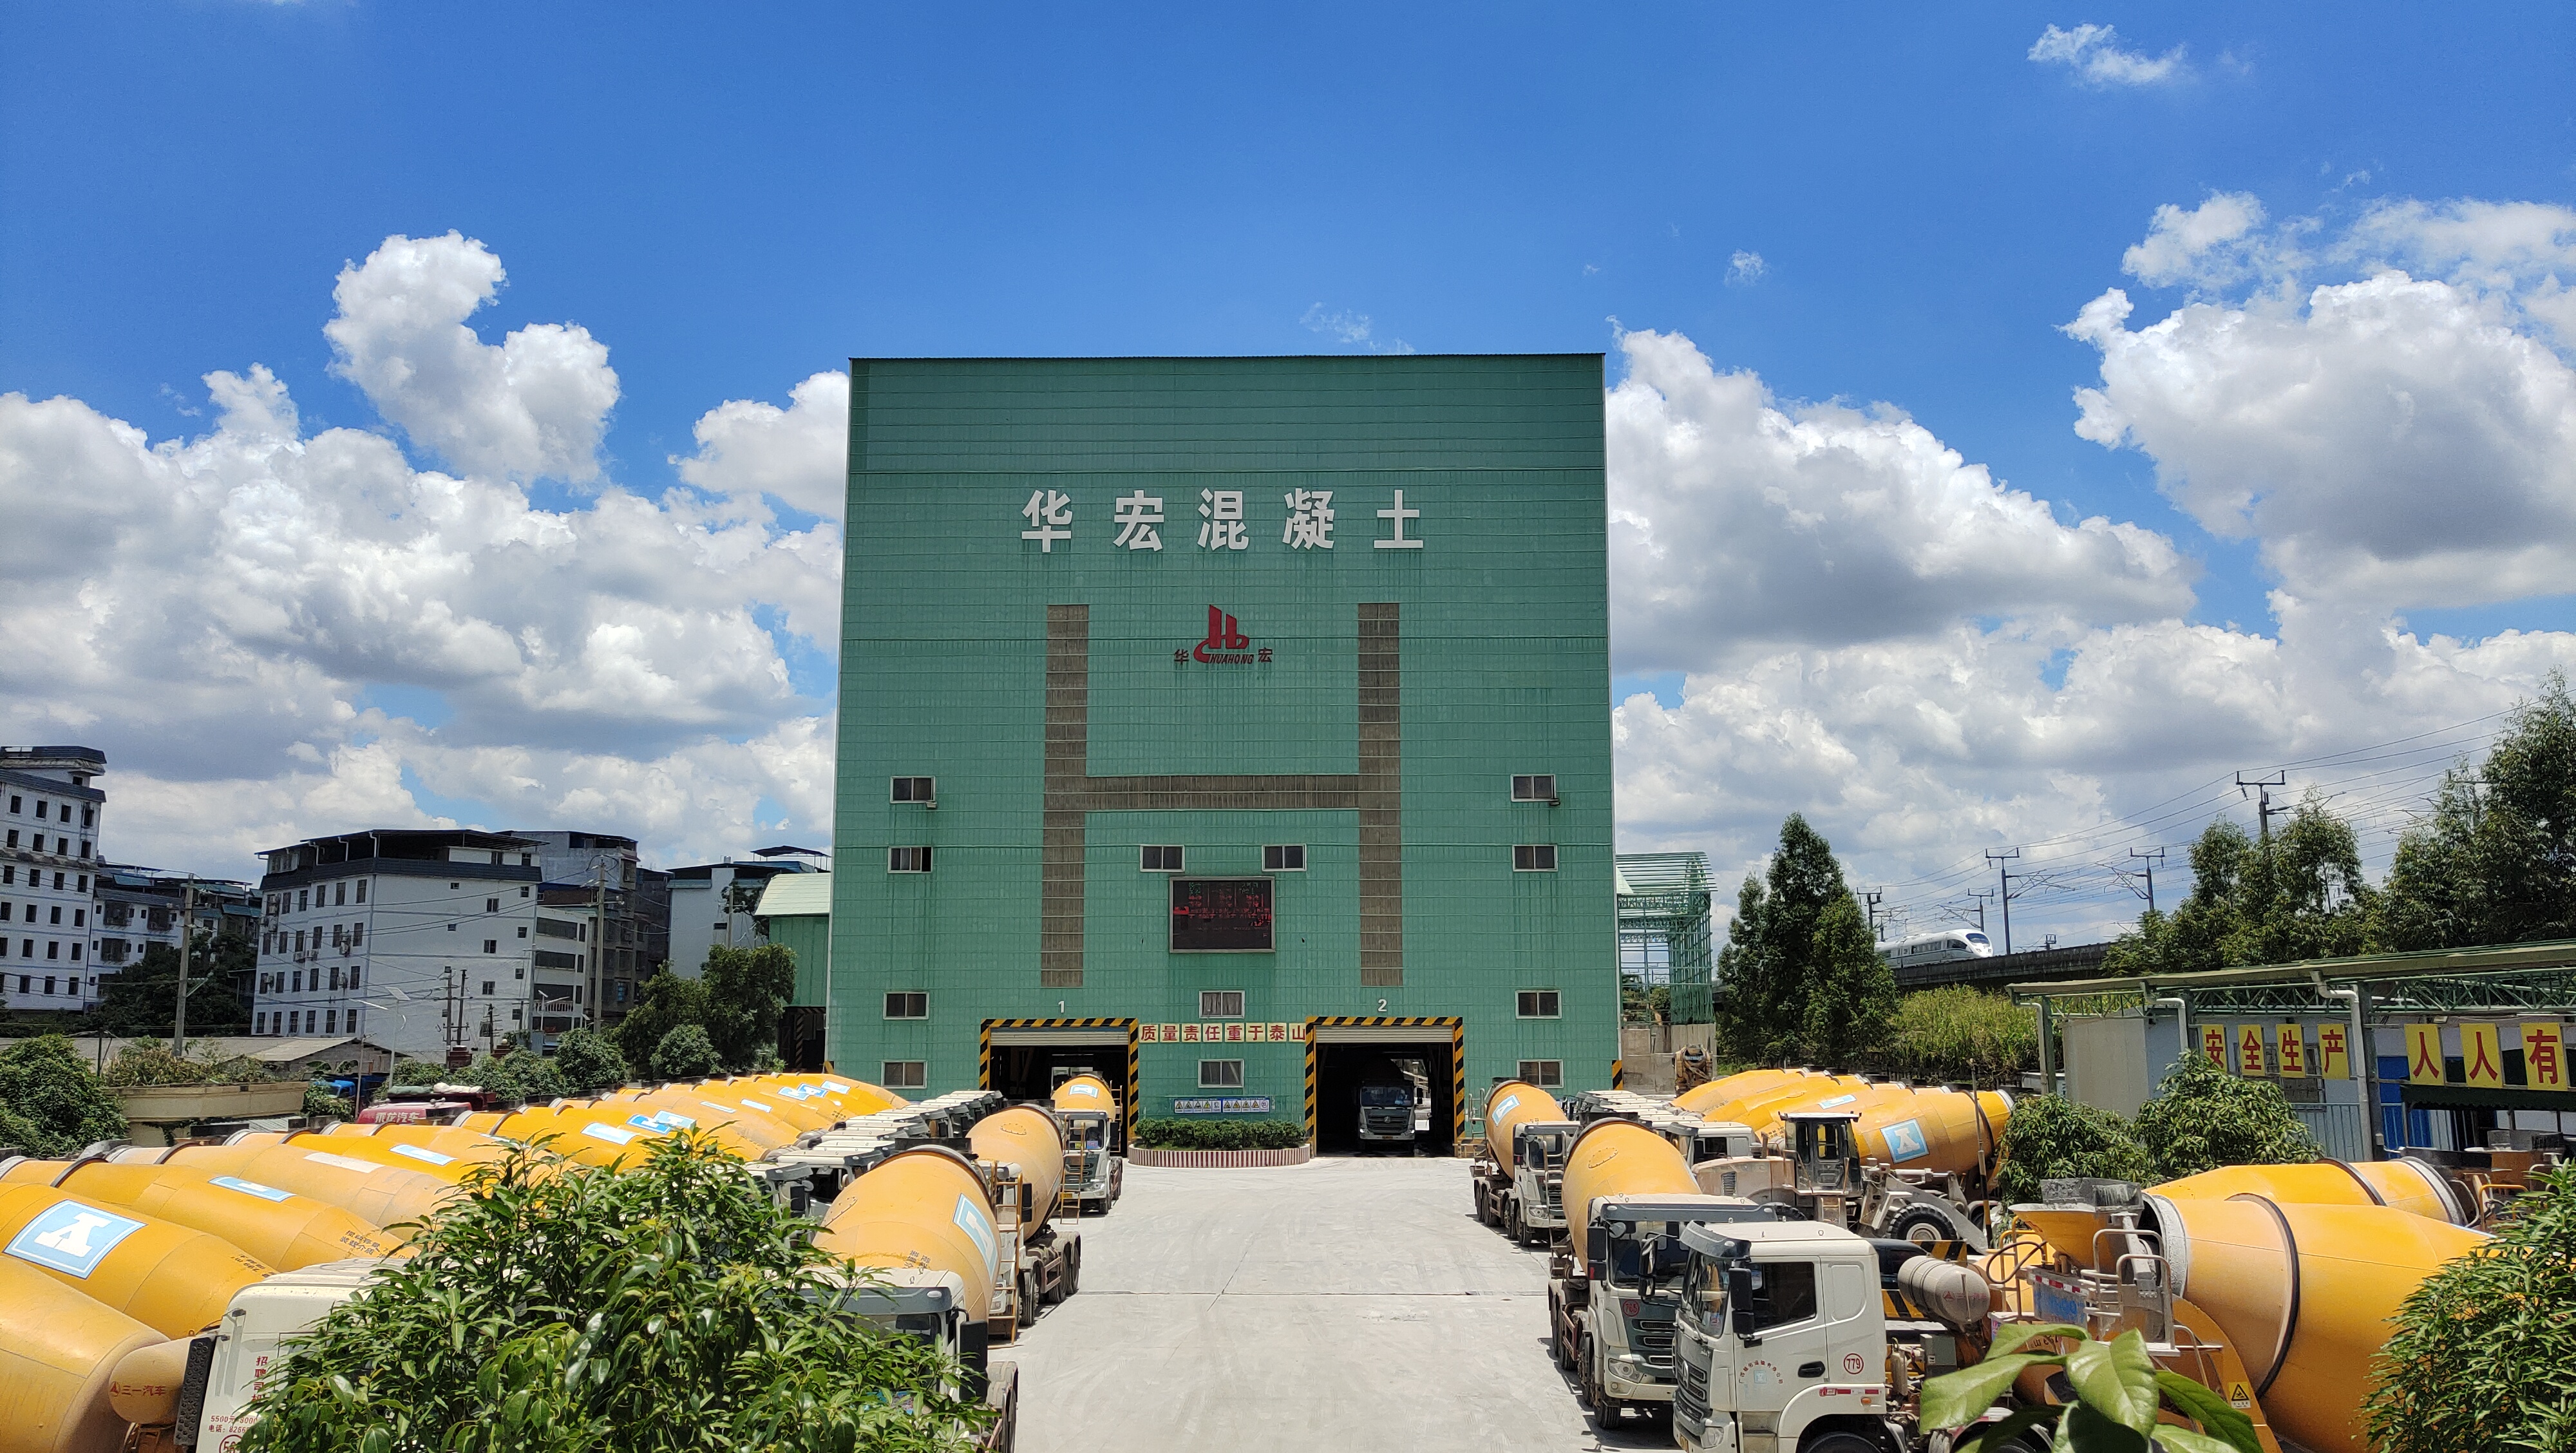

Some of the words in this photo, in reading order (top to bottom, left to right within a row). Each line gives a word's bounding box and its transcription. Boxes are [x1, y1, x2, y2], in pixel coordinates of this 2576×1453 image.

[1021, 488, 1424, 553] 华宏混凝土
[1174, 648, 1189, 665] 华
[1209, 654, 1255, 664] HUAHONG
[1258, 647, 1273, 663] 宏
[1057, 1000, 1065, 1013] 1
[1378, 998, 1387, 1012] 2
[1141, 1024, 1306, 1041] 质量责任重于泰山
[2204, 1029, 2344, 1074] 安全生产
[2412, 1029, 2559, 1085] 人人有
[1846, 1358, 1861, 1369] 779
[121, 1385, 166, 1396] 三一汽车
